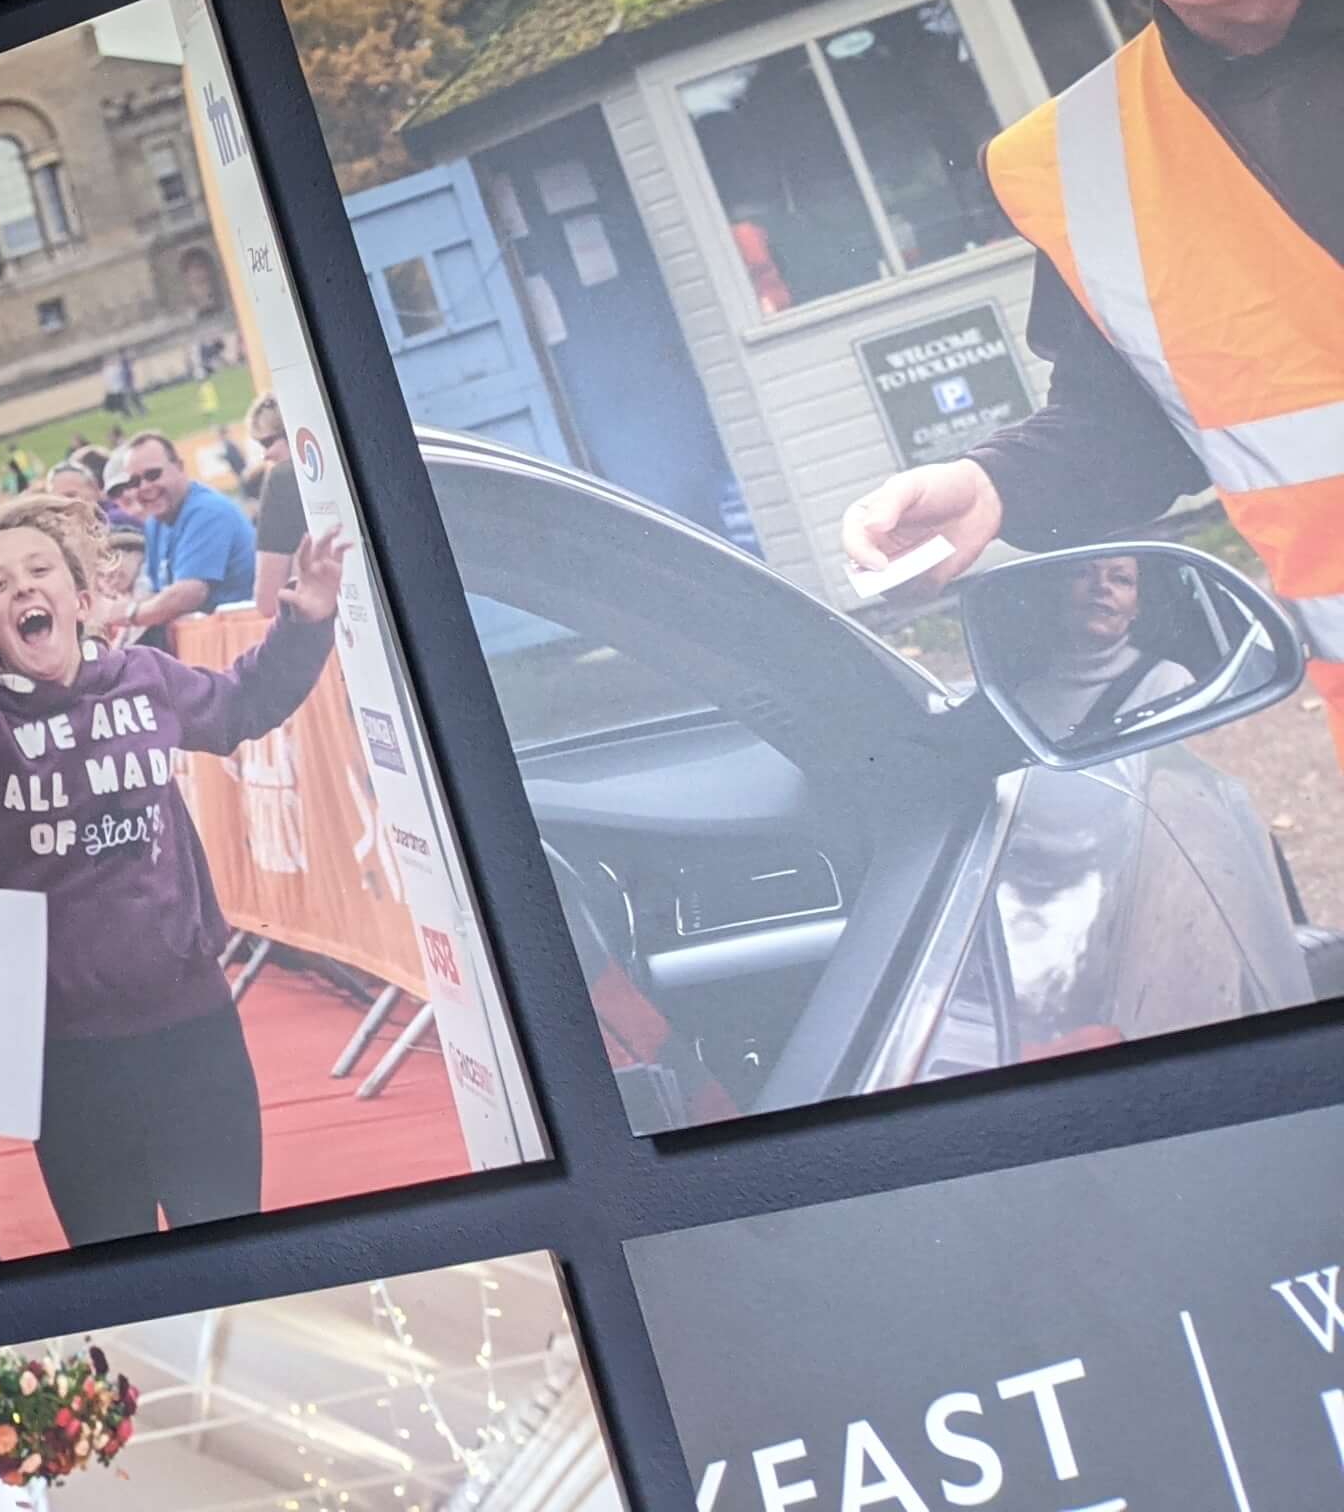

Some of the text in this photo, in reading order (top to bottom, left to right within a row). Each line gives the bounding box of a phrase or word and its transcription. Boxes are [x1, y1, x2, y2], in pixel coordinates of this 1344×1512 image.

[13, 694, 158, 759] WE ARE
[4, 772, 69, 812] ALL
[30, 819, 76, 856] OF
